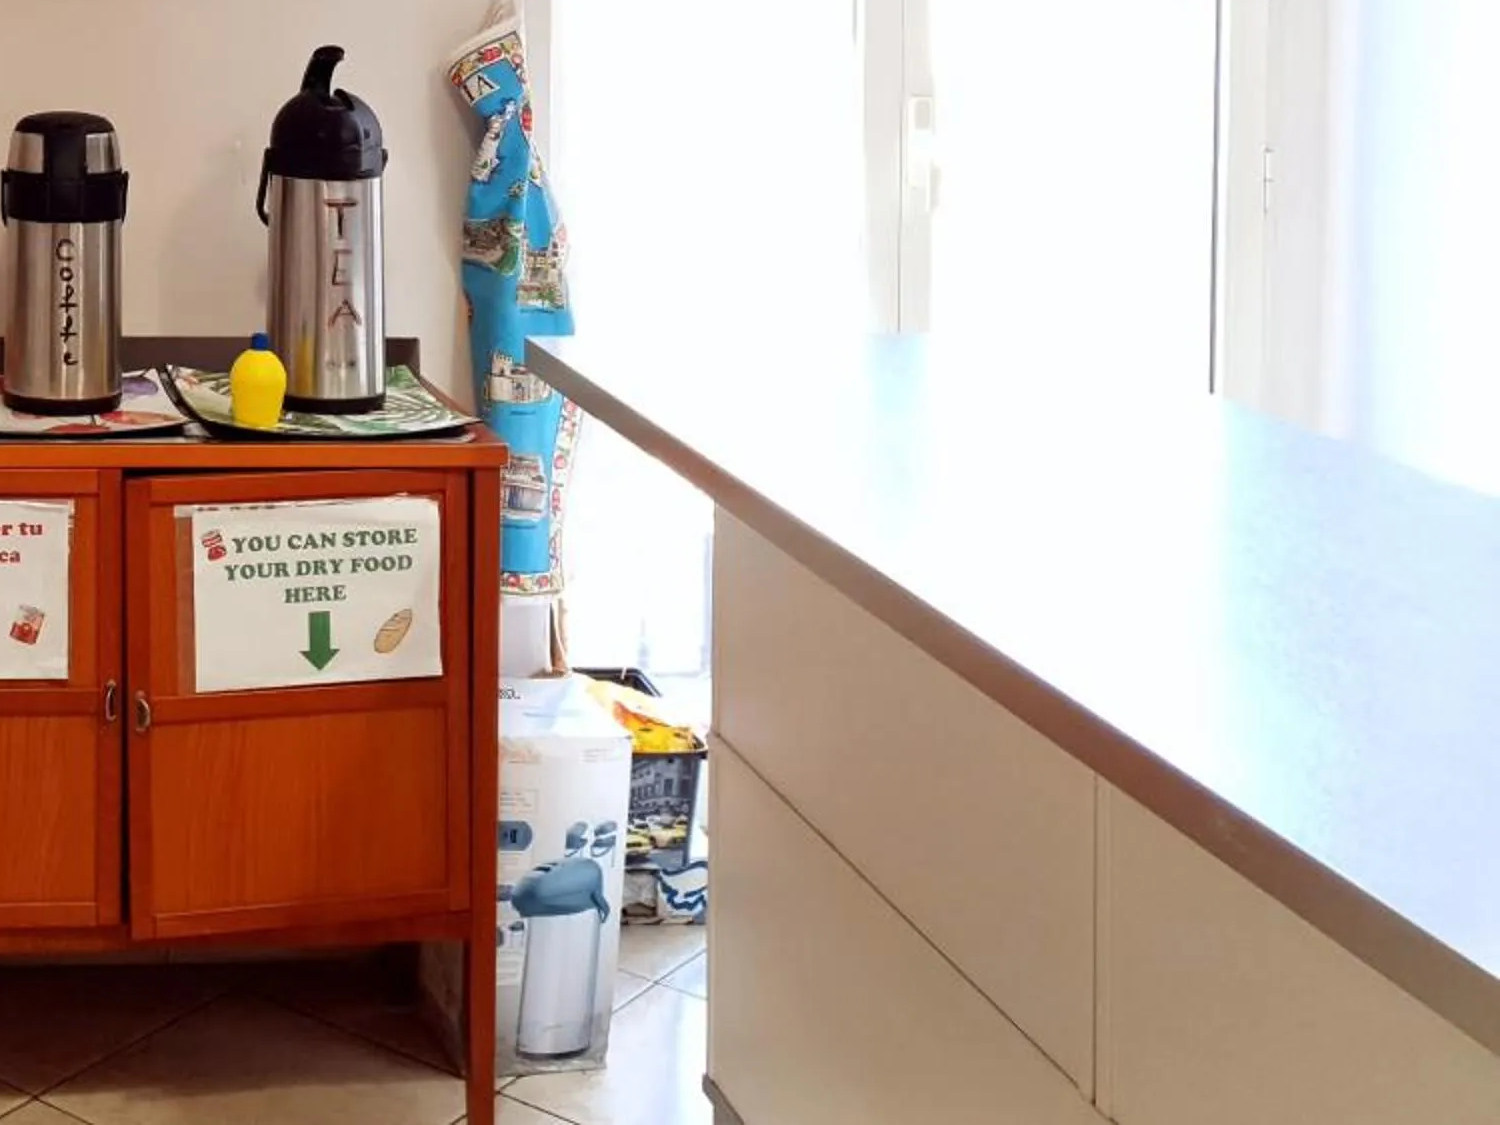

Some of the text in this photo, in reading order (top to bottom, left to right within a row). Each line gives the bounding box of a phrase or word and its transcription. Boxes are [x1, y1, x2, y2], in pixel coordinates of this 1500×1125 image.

[326, 197, 363, 329] TEA
[19, 521, 43, 537] tu
[231, 527, 418, 554] YOU CAN STORE
[224, 554, 413, 581] YOUR DRY FOOD
[284, 584, 347, 604] HERE
